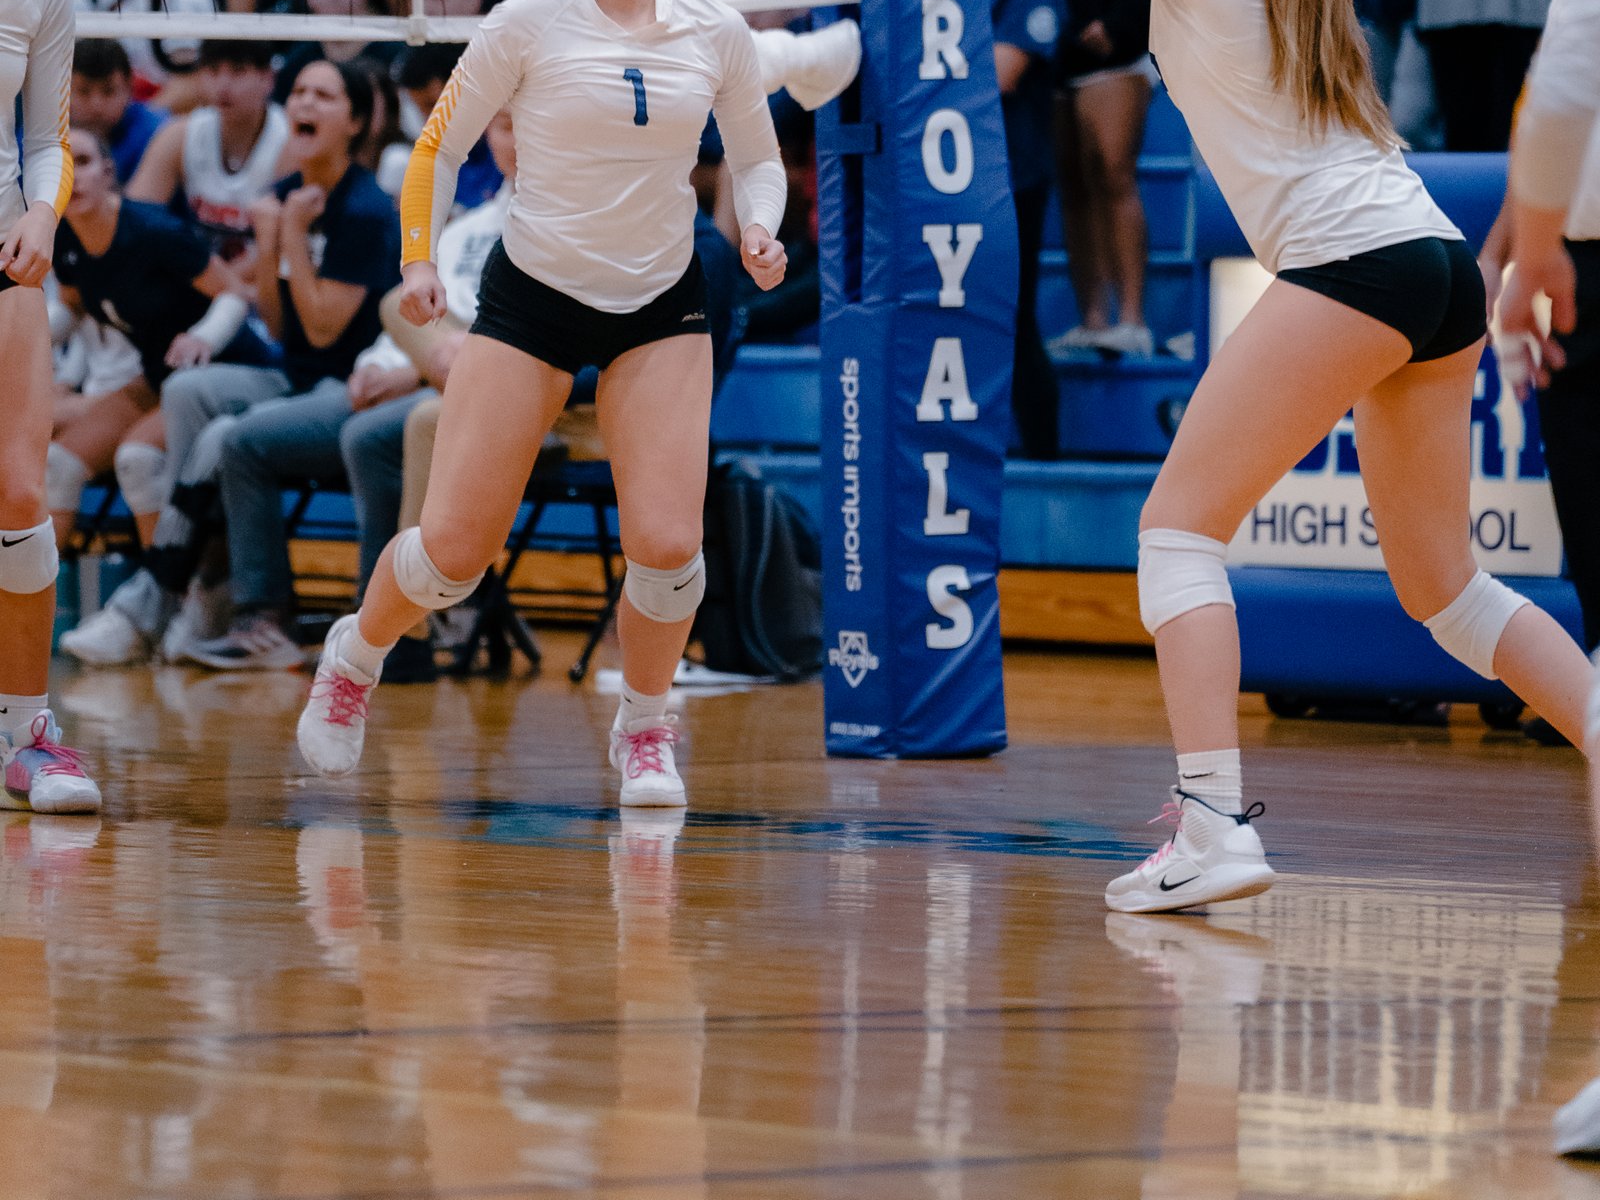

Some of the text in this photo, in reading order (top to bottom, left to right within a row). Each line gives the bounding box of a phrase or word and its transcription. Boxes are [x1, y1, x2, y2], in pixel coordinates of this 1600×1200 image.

[623, 68, 649, 126] 1
[839, 357, 863, 592] sports imports
[1251, 505, 1347, 544] HIGH
[828, 647, 880, 672] Royals
